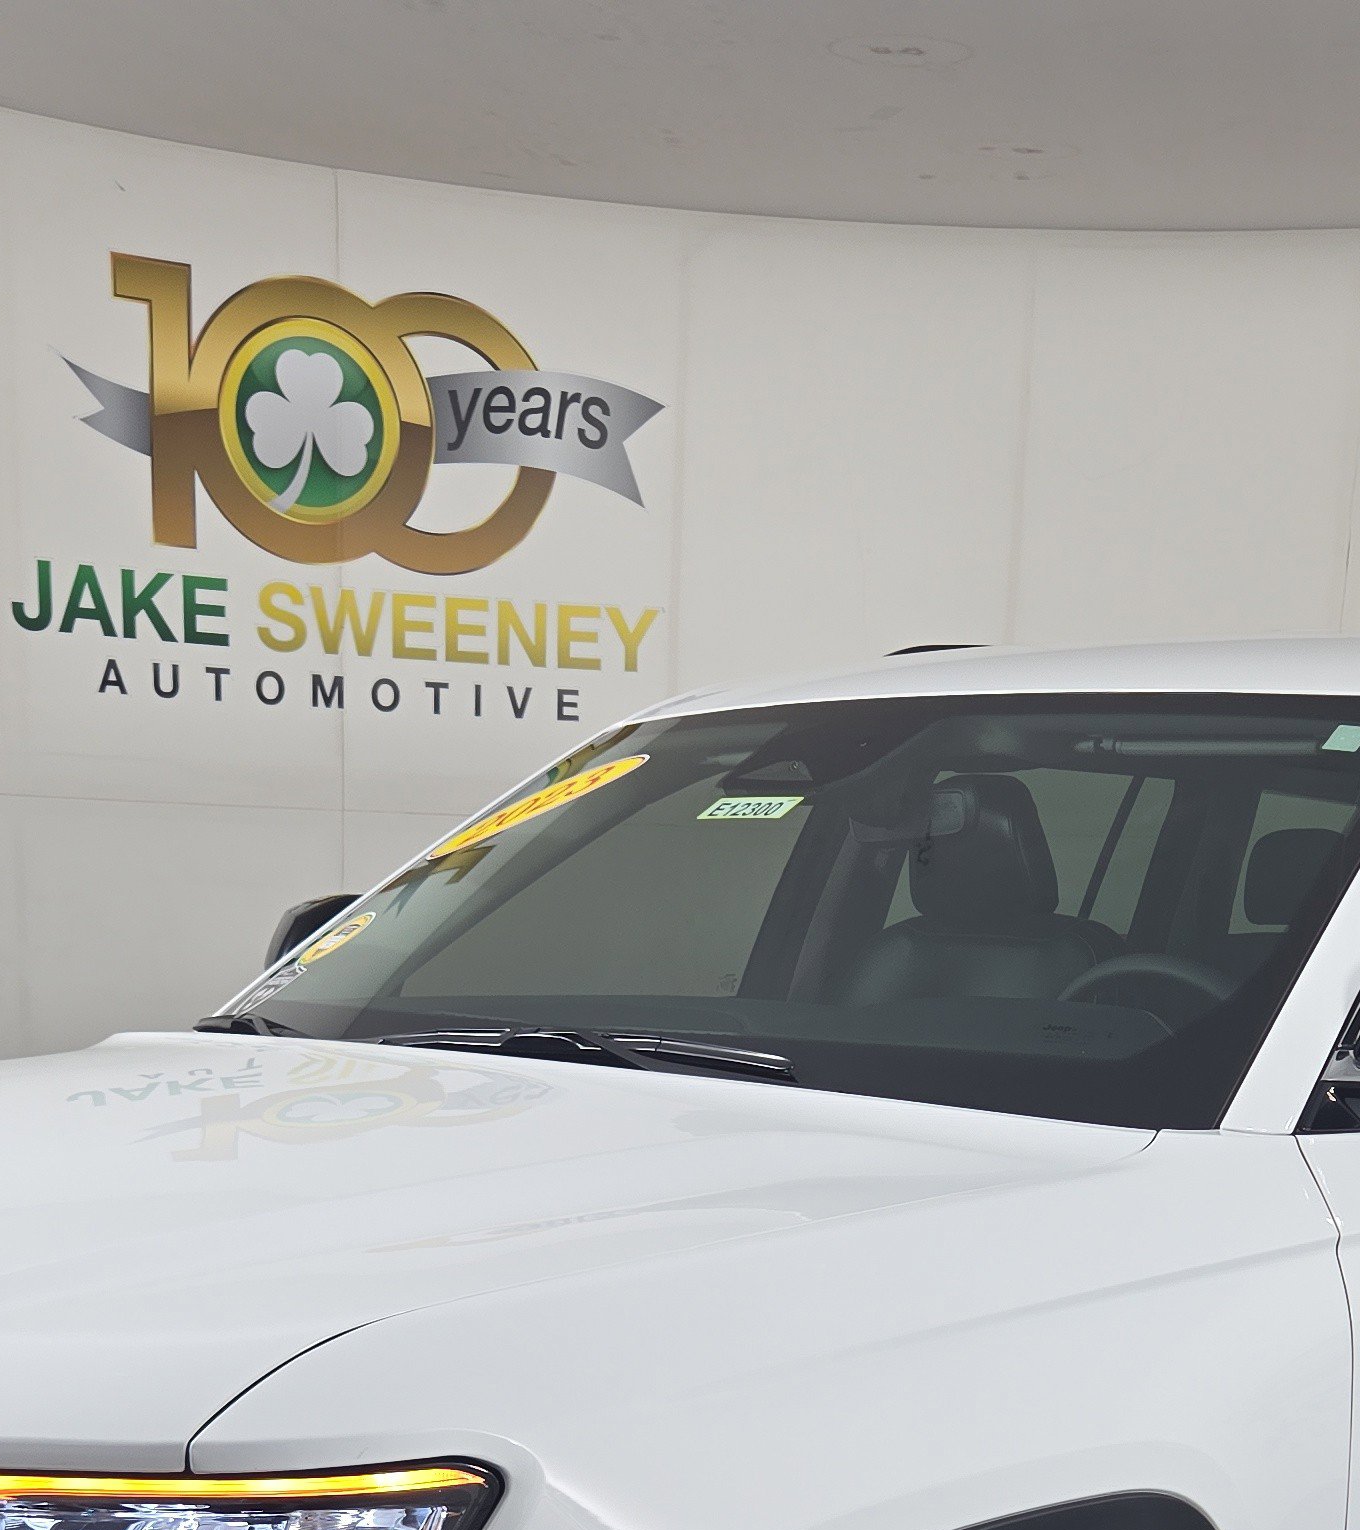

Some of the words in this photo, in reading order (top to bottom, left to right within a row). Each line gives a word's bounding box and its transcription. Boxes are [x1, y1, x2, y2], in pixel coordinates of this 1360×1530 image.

[110, 251, 556, 575] 100
[446, 384, 612, 452] years
[12, 559, 230, 647] JAKE
[257, 581, 660, 673] SWEENEY
[98, 658, 580, 722] AUTOMOTIVE
[708, 802, 784, 817] E12300
